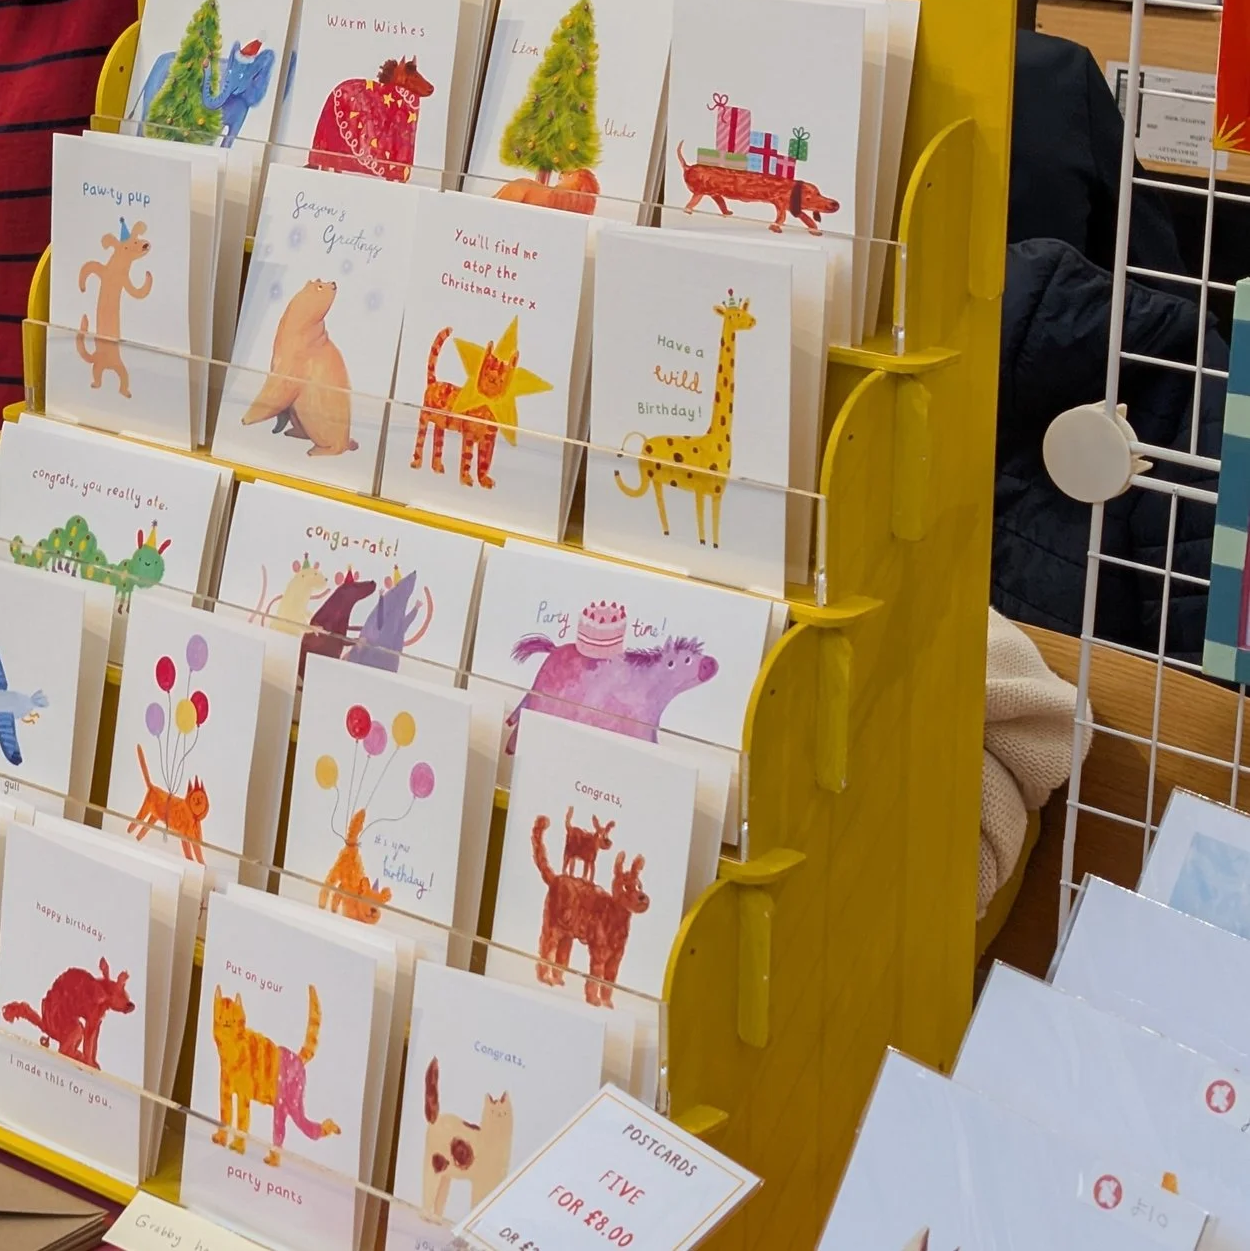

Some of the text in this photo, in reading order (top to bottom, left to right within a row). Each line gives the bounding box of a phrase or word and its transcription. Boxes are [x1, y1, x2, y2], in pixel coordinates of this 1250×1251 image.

[327, 14, 426, 38] Warm Wishes
[512, 37, 539, 57] Lion
[127, 189, 151, 208] pup
[292, 191, 347, 222] Season's
[322, 224, 383, 265] Greetings
[455, 228, 538, 261] You'll find me
[463, 259, 518, 282] atop the
[441, 272, 497, 299] Christmas
[501, 291, 526, 307] tree
[657, 334, 705, 358] Have a
[637, 401, 703, 423] Birthday!
[82, 478, 103, 499] you
[106, 485, 143, 510] really
[306, 524, 400, 558] conga-rats!
[536, 600, 571, 639] Party
[632, 617, 668, 638] time!
[4, 779, 21, 795] gull
[574, 780, 623, 808] Congrats,
[383, 855, 434, 900] birthday!
[35, 902, 62, 924] happy
[226, 960, 284, 994] Put on your
[16, 1059, 42, 1078] made
[45, 1070, 66, 1088] this
[69, 1081, 85, 1096] for
[88, 1091, 113, 1110] you.
[622, 1123, 698, 1178] POSTCARDS
[227, 1165, 304, 1206] party pants
[598, 1169, 646, 1206] FIVE
[548, 1185, 635, 1249] FOR £8.00
[499, 1227, 521, 1245] OR
